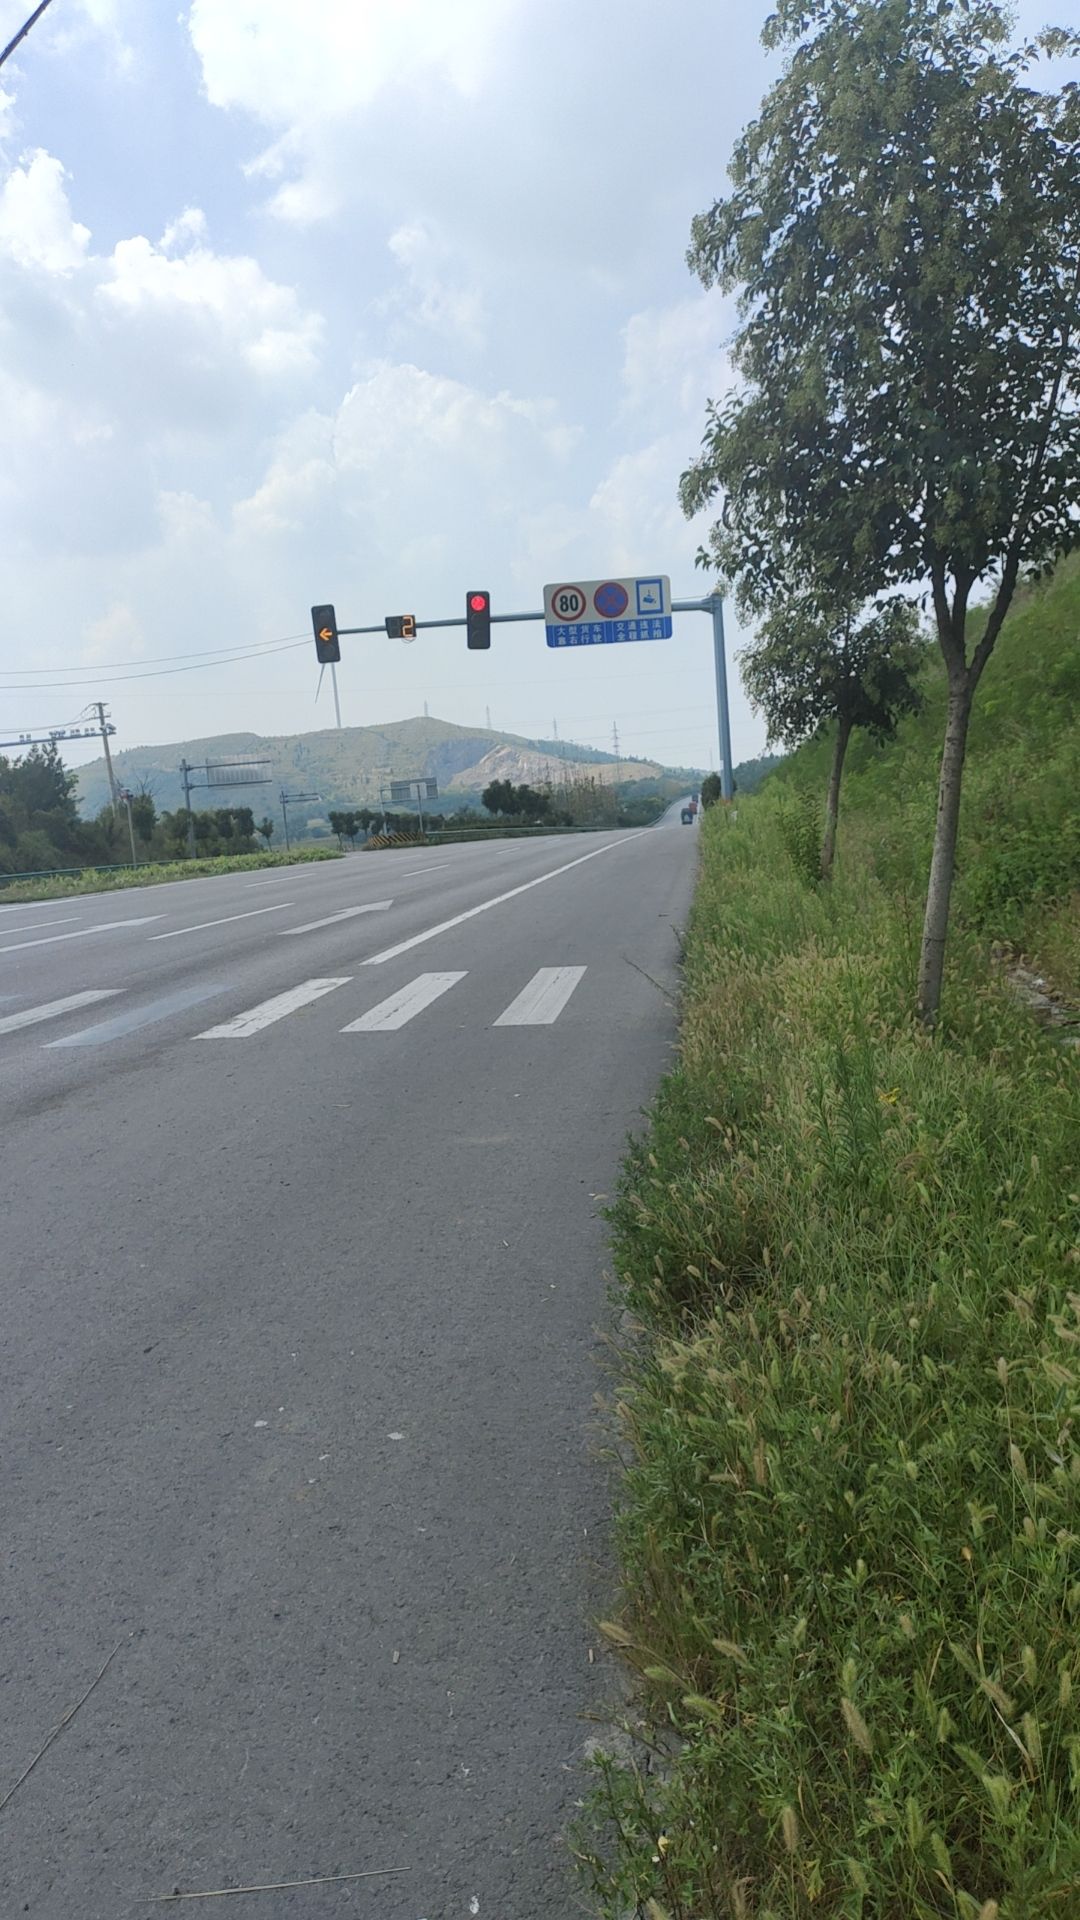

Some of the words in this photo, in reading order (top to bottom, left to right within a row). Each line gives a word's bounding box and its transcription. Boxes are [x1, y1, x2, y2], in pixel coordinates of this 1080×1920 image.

[559, 595, 579, 612] 80
[557, 624, 602, 636] 大型货车
[616, 619, 661, 631] 交通违法
